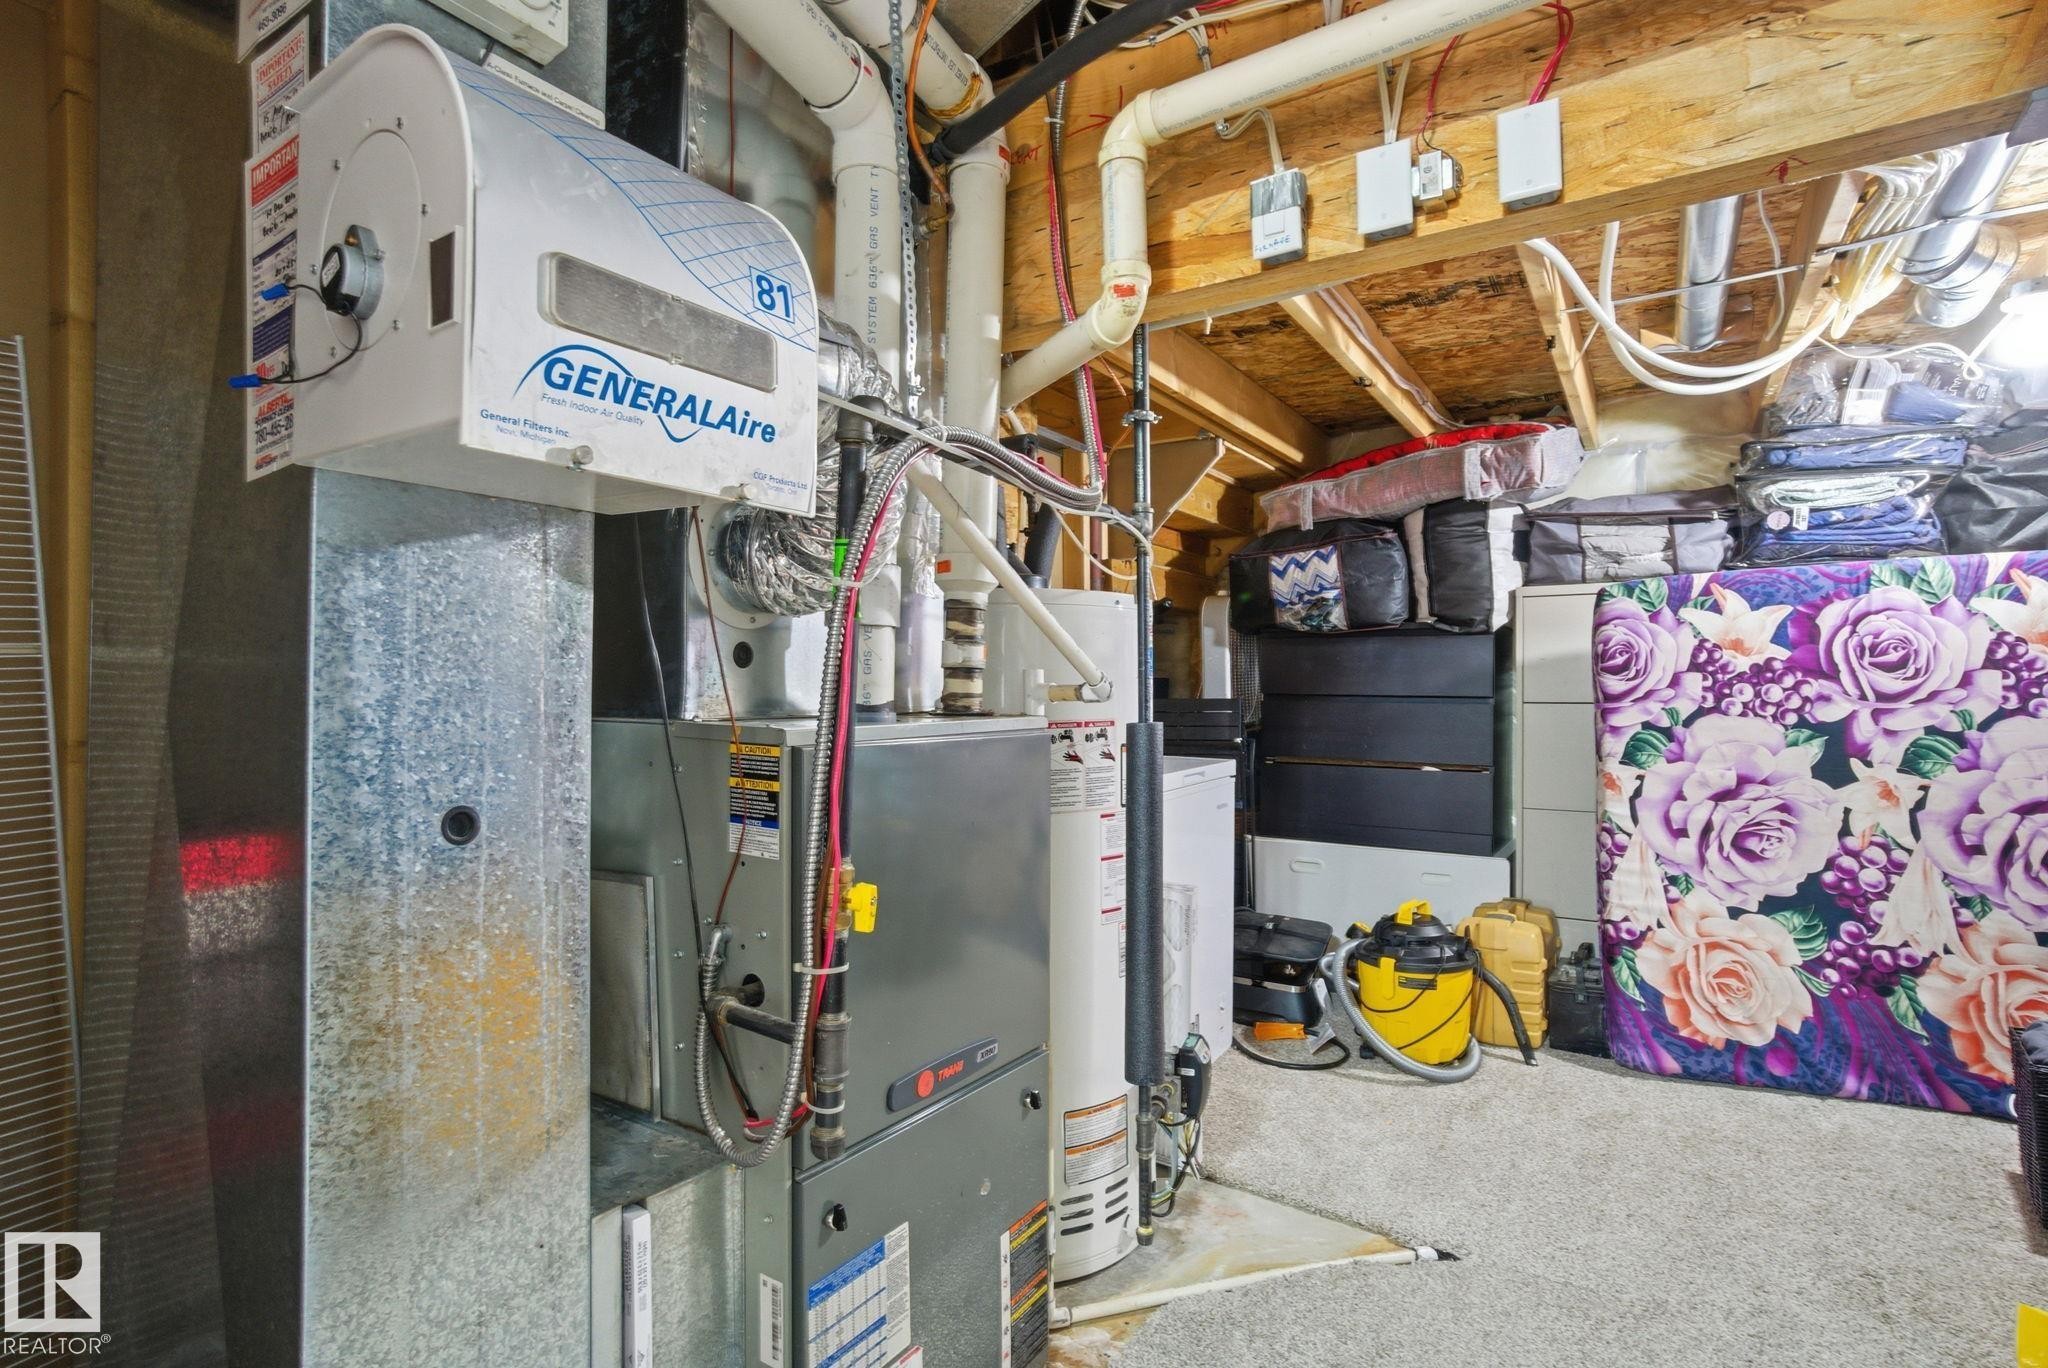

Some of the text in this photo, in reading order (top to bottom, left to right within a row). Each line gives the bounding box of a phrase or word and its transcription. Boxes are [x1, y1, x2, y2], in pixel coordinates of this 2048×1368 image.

[869, 186, 879, 217] VENT
[869, 225, 879, 249] GAS
[756, 274, 791, 318] 81
[868, 296, 877, 344] SYSTEM
[541, 393, 645, 427] Fresh Indoor Air Quality
[543, 356, 776, 443] GENERALAire
[480, 409, 520, 427] General
[523, 419, 553, 434] Filters
[520, 430, 557, 445] Michigan
[769, 474, 796, 488] Products
[864, 648, 873, 675] GAS
[744, 745, 772, 756] CAUTION
